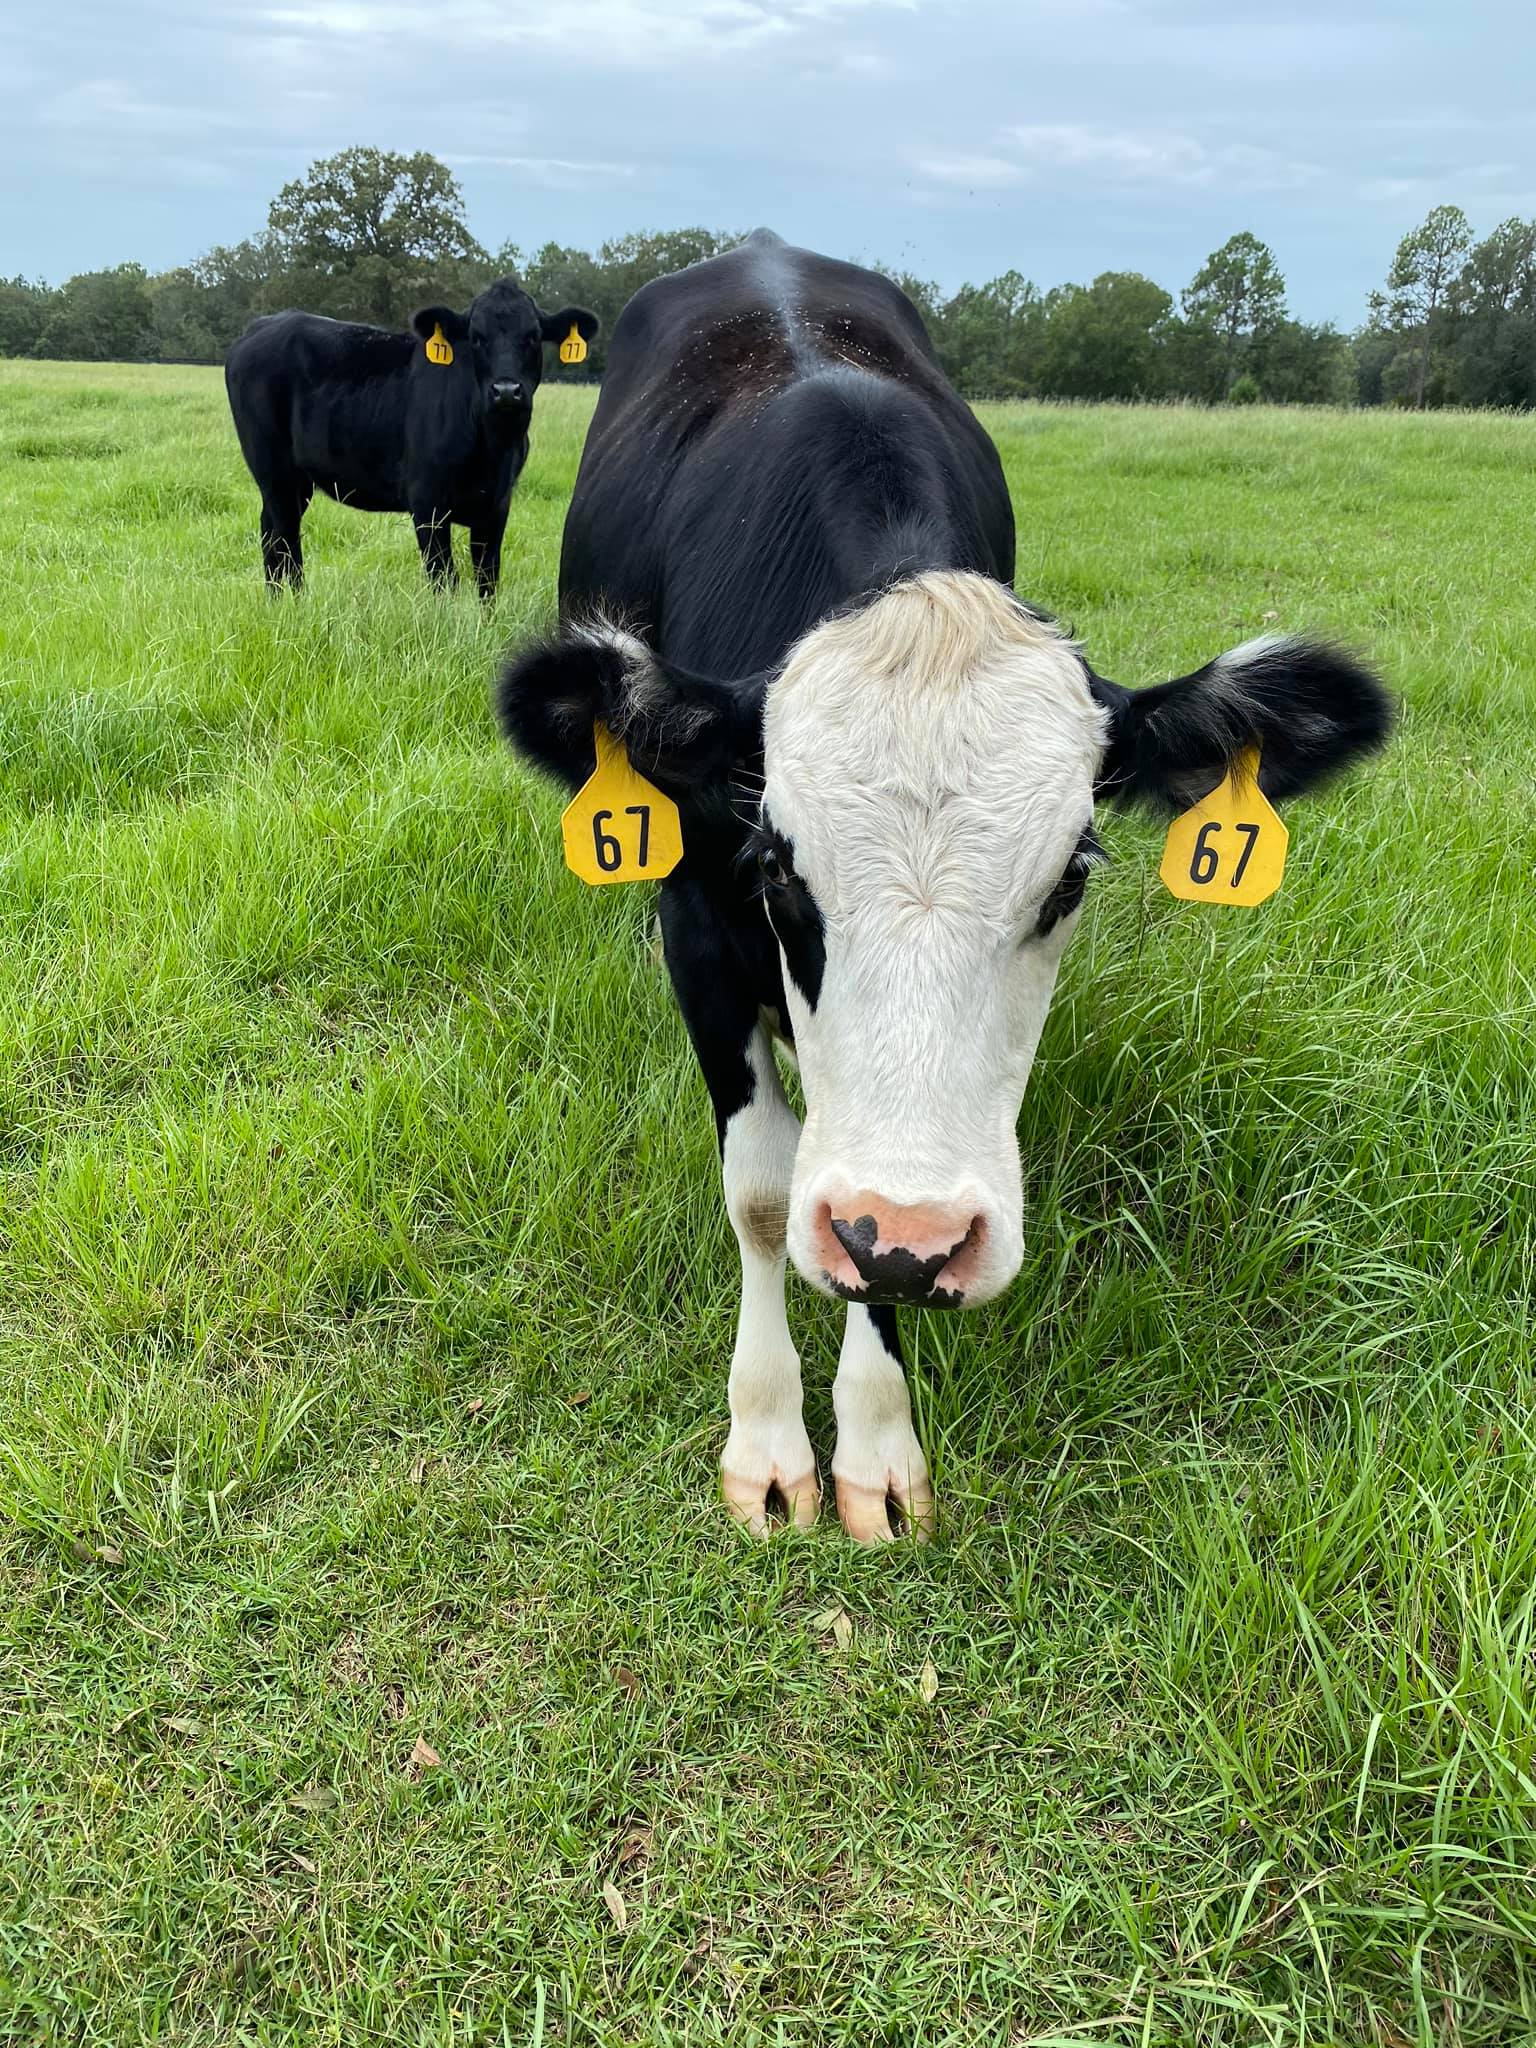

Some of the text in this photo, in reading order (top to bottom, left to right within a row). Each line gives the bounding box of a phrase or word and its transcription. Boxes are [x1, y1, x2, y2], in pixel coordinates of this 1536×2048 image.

[433, 342, 448, 361] 77
[566, 342, 581, 360] 77
[592, 805, 650, 872] 67
[1189, 821, 1260, 888] 67
